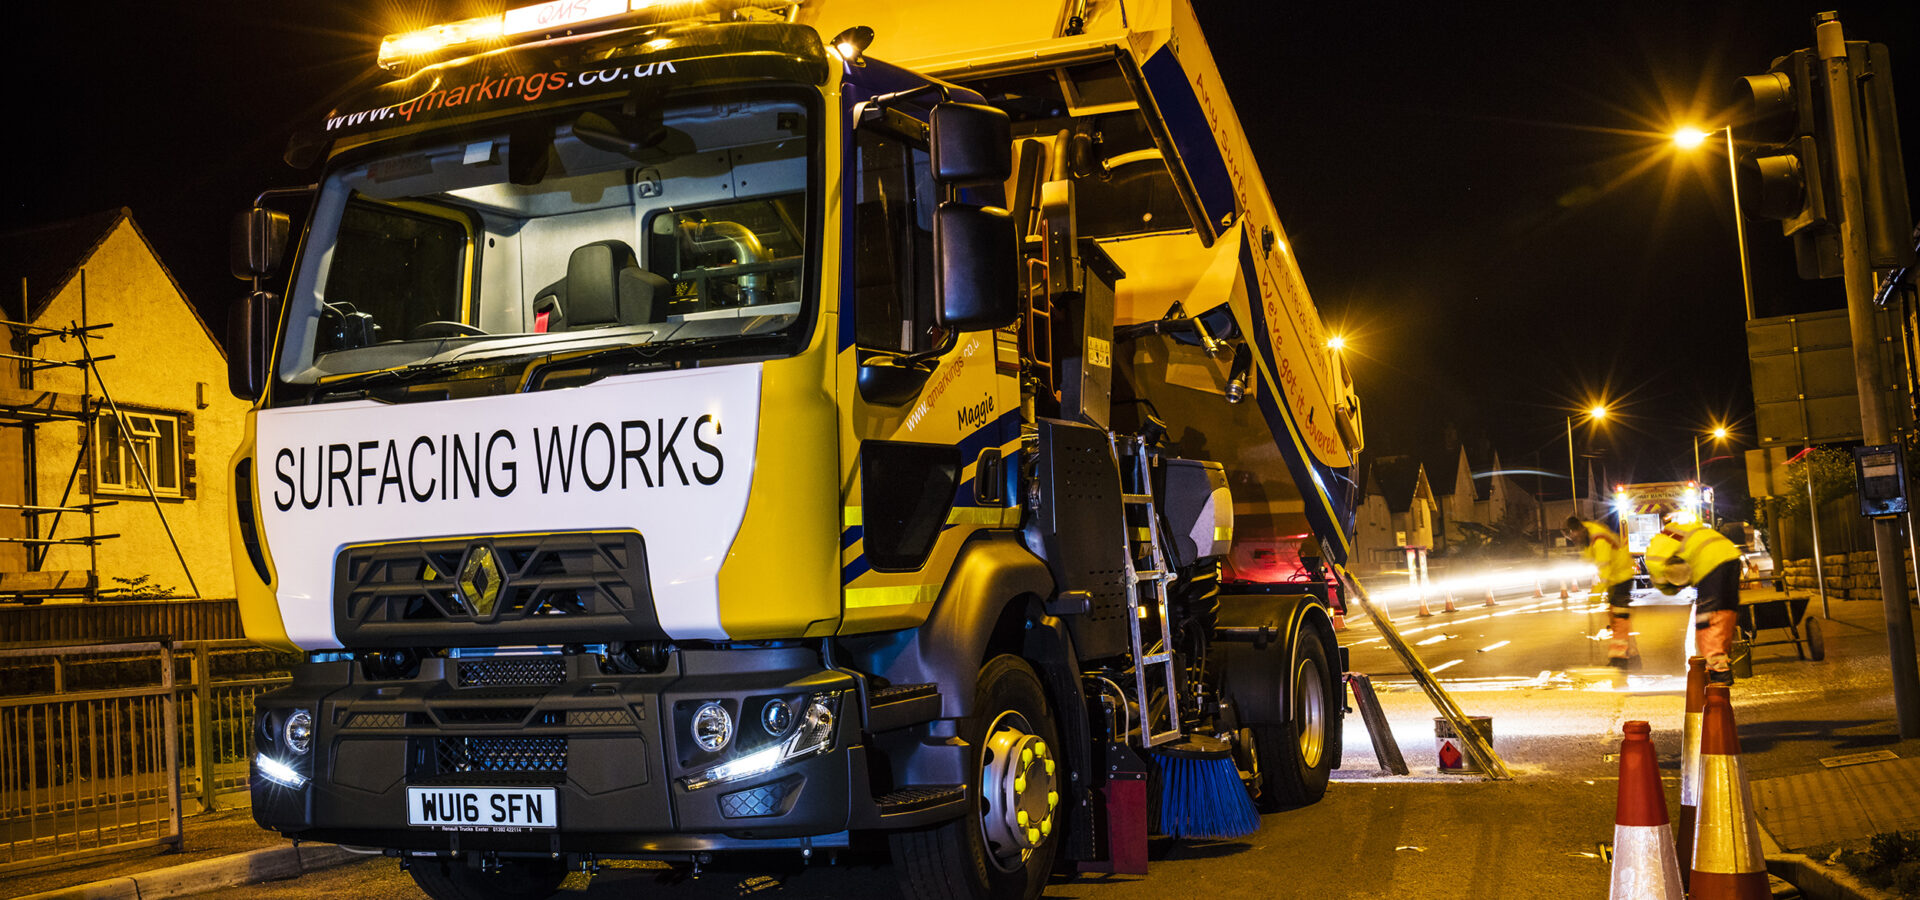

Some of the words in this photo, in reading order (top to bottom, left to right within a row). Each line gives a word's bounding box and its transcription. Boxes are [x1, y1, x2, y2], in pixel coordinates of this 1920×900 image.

[538, 0, 589, 25] QMS
[326, 61, 677, 131] www.qmarkings.co.uk
[1196, 72, 1218, 133] Any
[1261, 267, 1284, 352] We've
[1279, 358, 1298, 396] got
[1295, 389, 1305, 417] it
[957, 391, 995, 431] Maggie
[273, 428, 518, 512] SURFACING
[532, 413, 725, 495] WORKS
[421, 793, 479, 822] WU16
[490, 793, 543, 824] SFN
